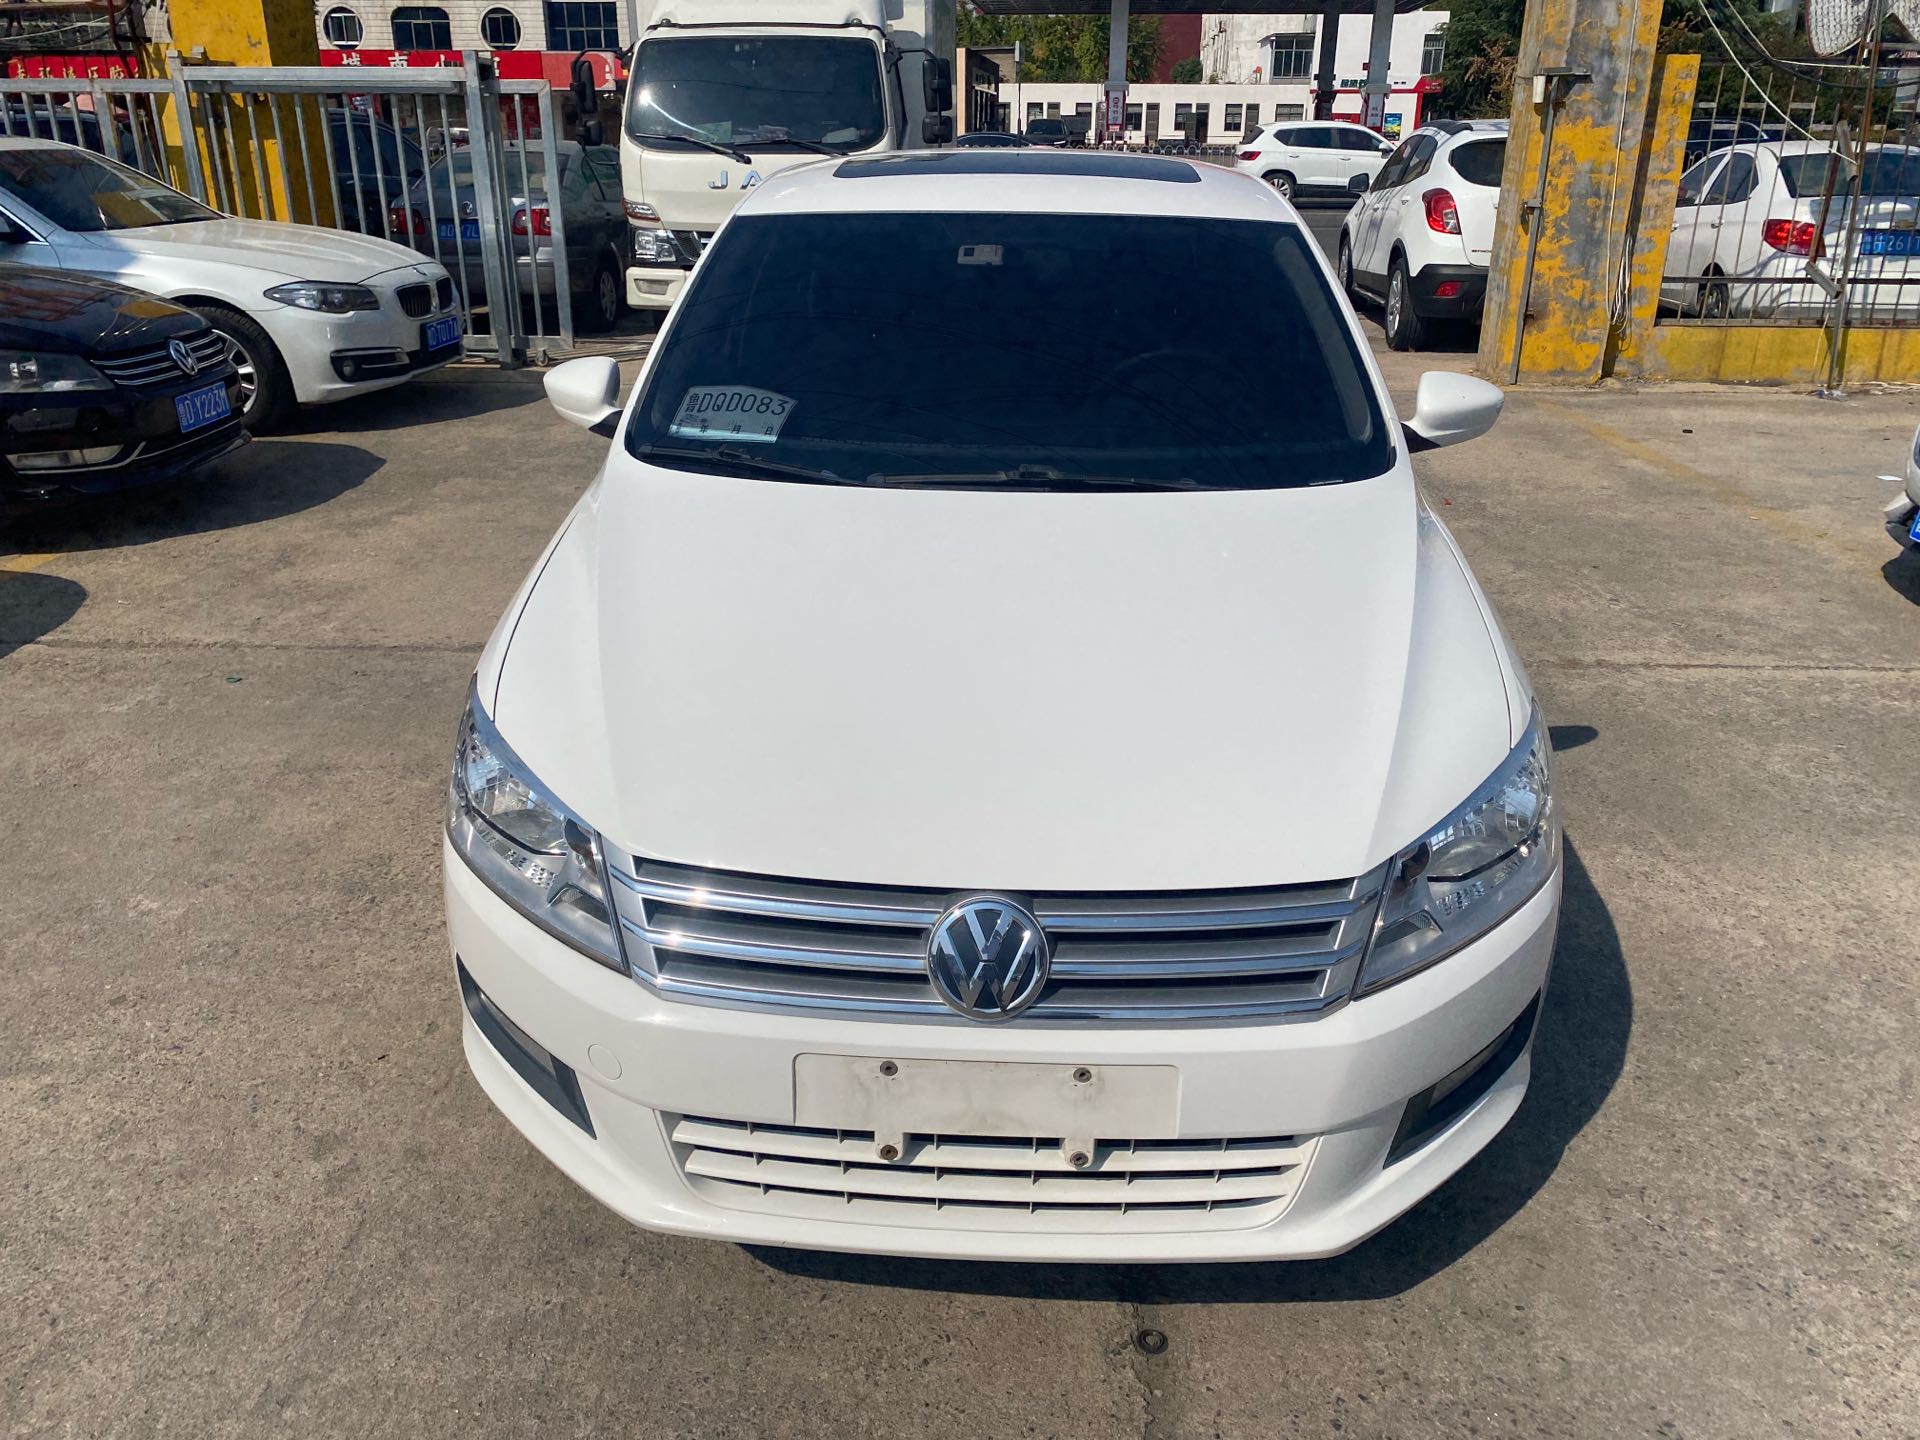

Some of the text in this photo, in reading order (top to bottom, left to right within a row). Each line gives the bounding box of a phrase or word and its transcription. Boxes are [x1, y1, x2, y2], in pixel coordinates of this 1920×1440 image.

[685, 392, 790, 416] 鲁DQD083
[730, 424, 742, 434] 月
[764, 426, 774, 435] 日
